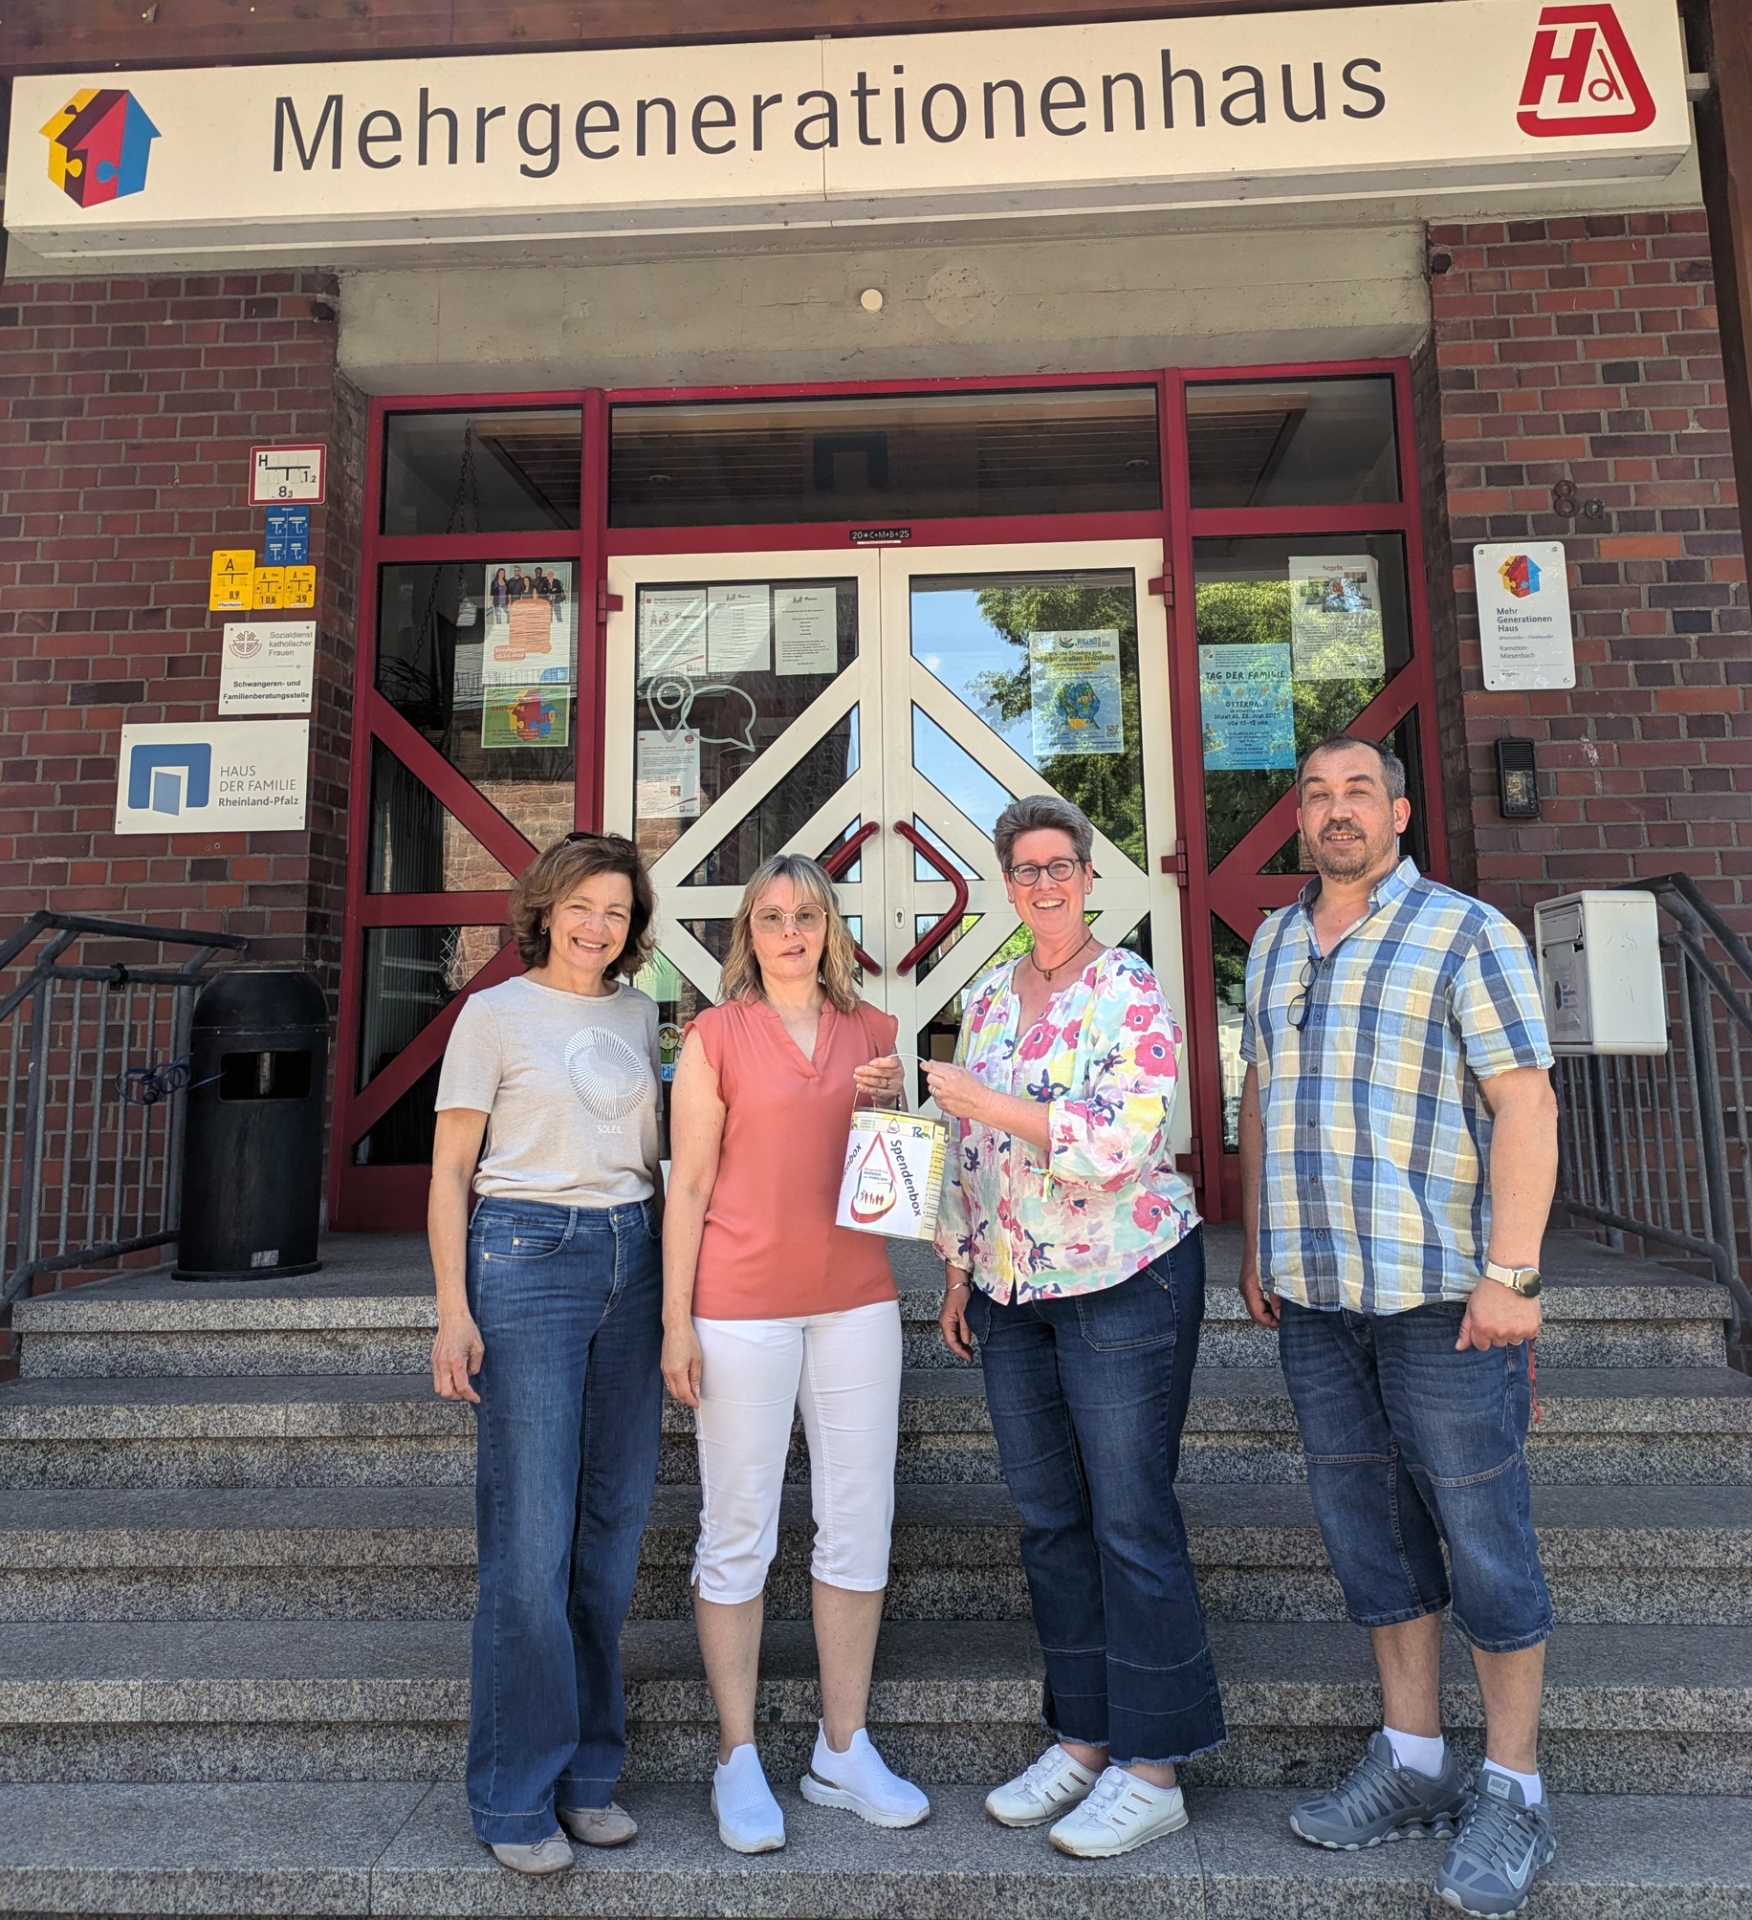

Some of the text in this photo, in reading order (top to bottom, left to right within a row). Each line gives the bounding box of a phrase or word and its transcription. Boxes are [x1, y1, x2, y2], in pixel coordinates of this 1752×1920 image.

[272, 49, 1387, 178] Mehrgenerationenhaus
[259, 454, 268, 467] H
[225, 558, 235, 571] A
[262, 572, 267, 580] A
[293, 571, 298, 579] A
[1496, 607, 1519, 615] Mehr
[1497, 615, 1553, 624] Generationen
[269, 631, 313, 639] Sozialdienst
[269, 640, 312, 648] katholischer
[1205, 670, 1286, 680] TAG DER FAMILIE
[233, 680, 285, 688] Schwangeren-
[223, 692, 310, 700] Familienberatungsstelle
[220, 765, 256, 777] HAUS
[219, 779, 296, 792] DER FAMILIE
[218, 796, 299, 807] Rheinland-Pfalz
[597, 1125, 623, 1134] SOLEIL
[890, 1139, 921, 1217] Spendenbox
[1490, 1778, 1508, 1792] NIKE
